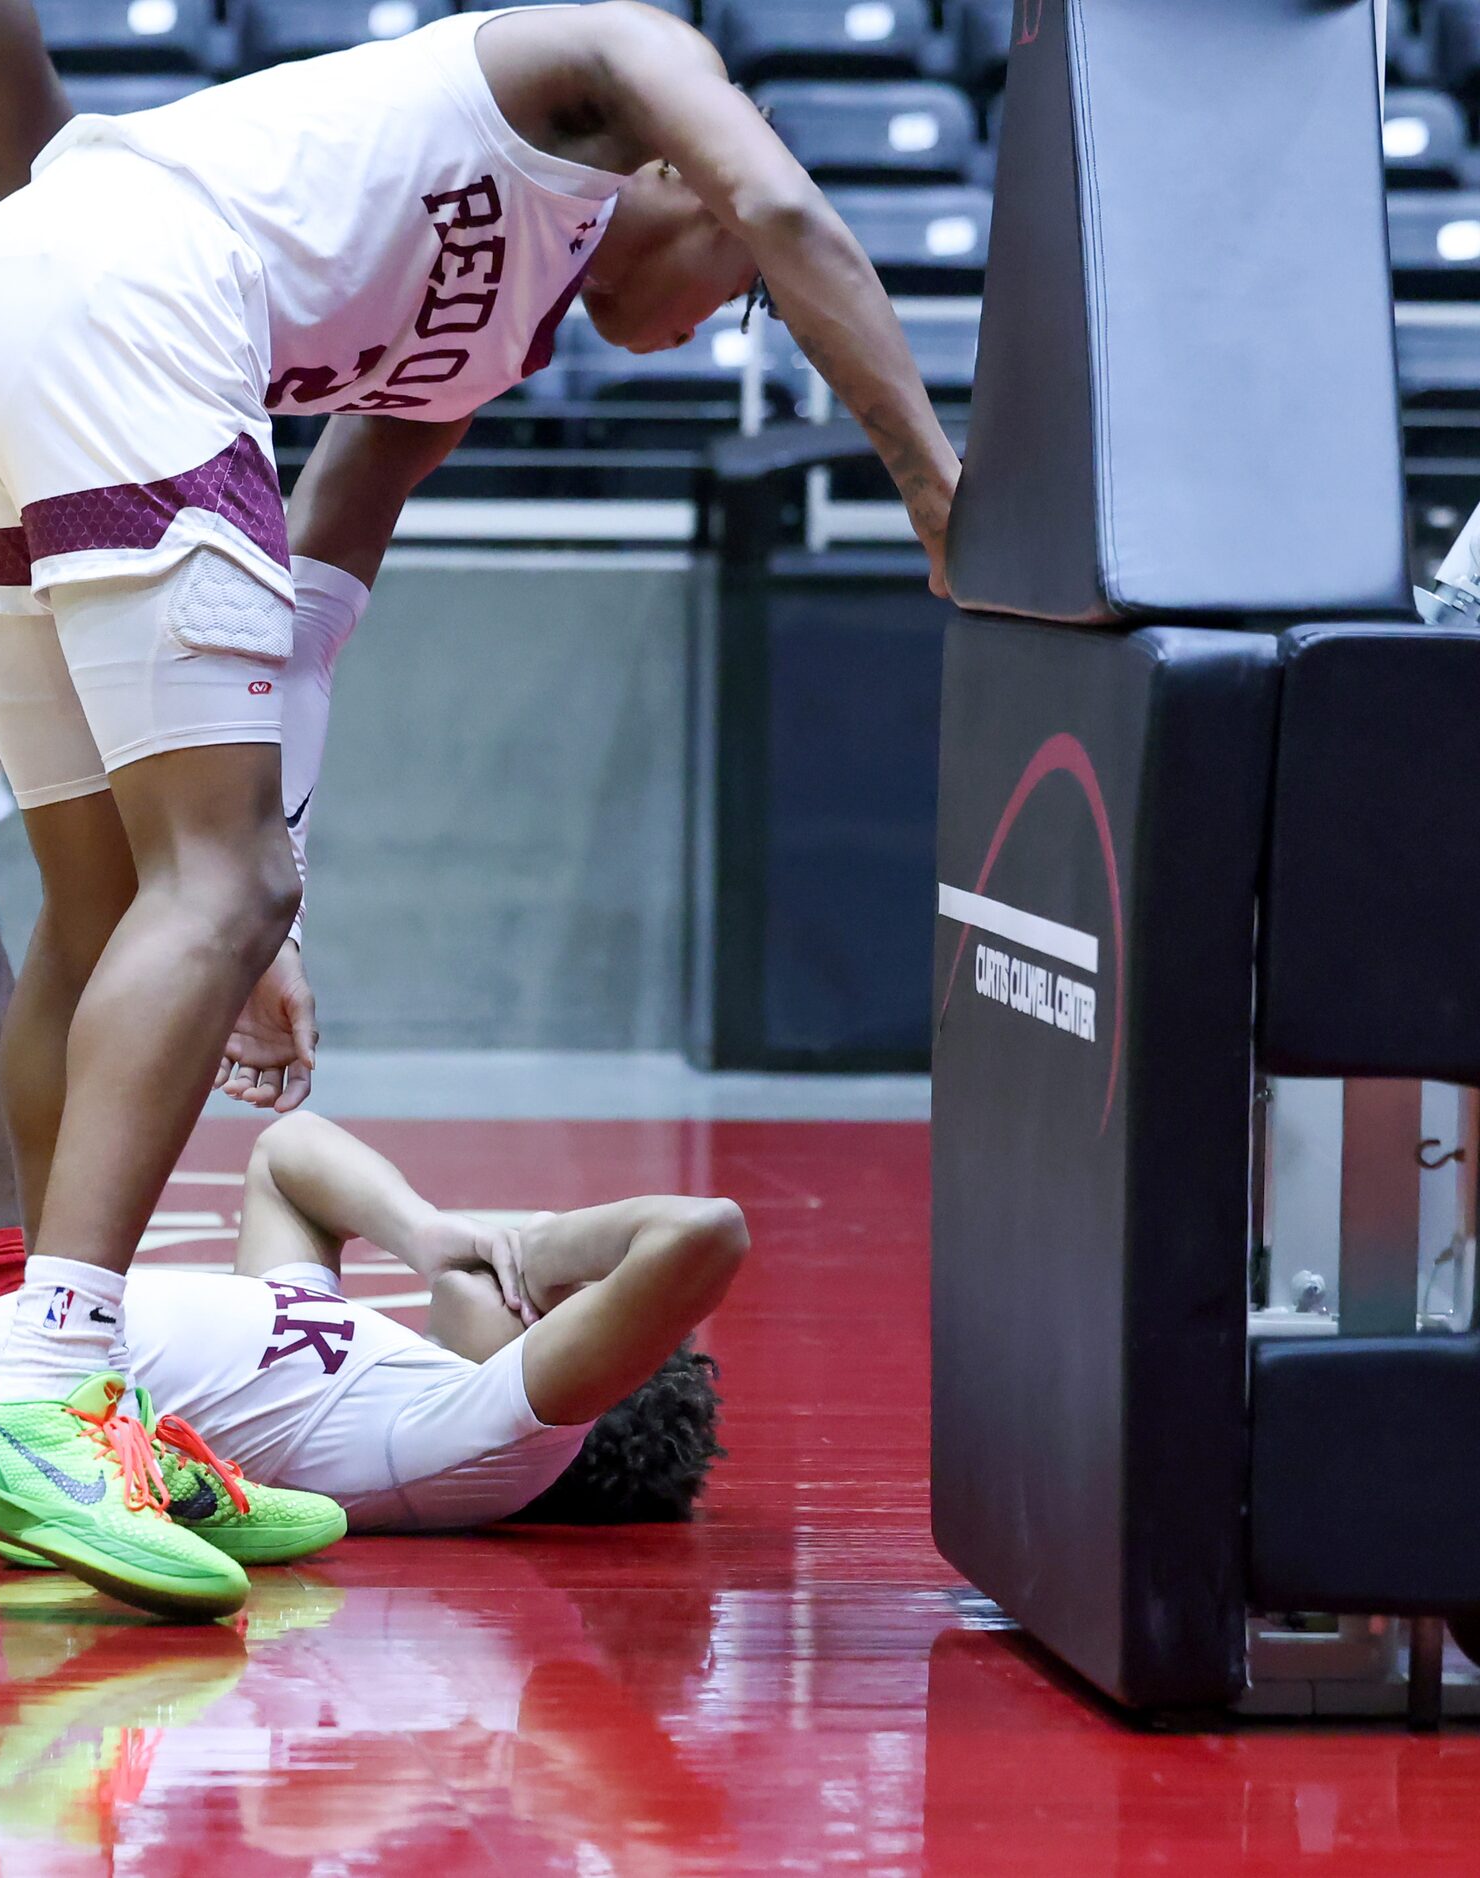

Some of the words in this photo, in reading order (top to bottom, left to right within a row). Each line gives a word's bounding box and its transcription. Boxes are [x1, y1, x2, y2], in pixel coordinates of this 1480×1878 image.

[415, 174, 506, 339] RED
[975, 943, 1010, 1006] CURTIS
[1009, 957, 1055, 1026] CULWELL
[1054, 974, 1097, 1043] CENTER
